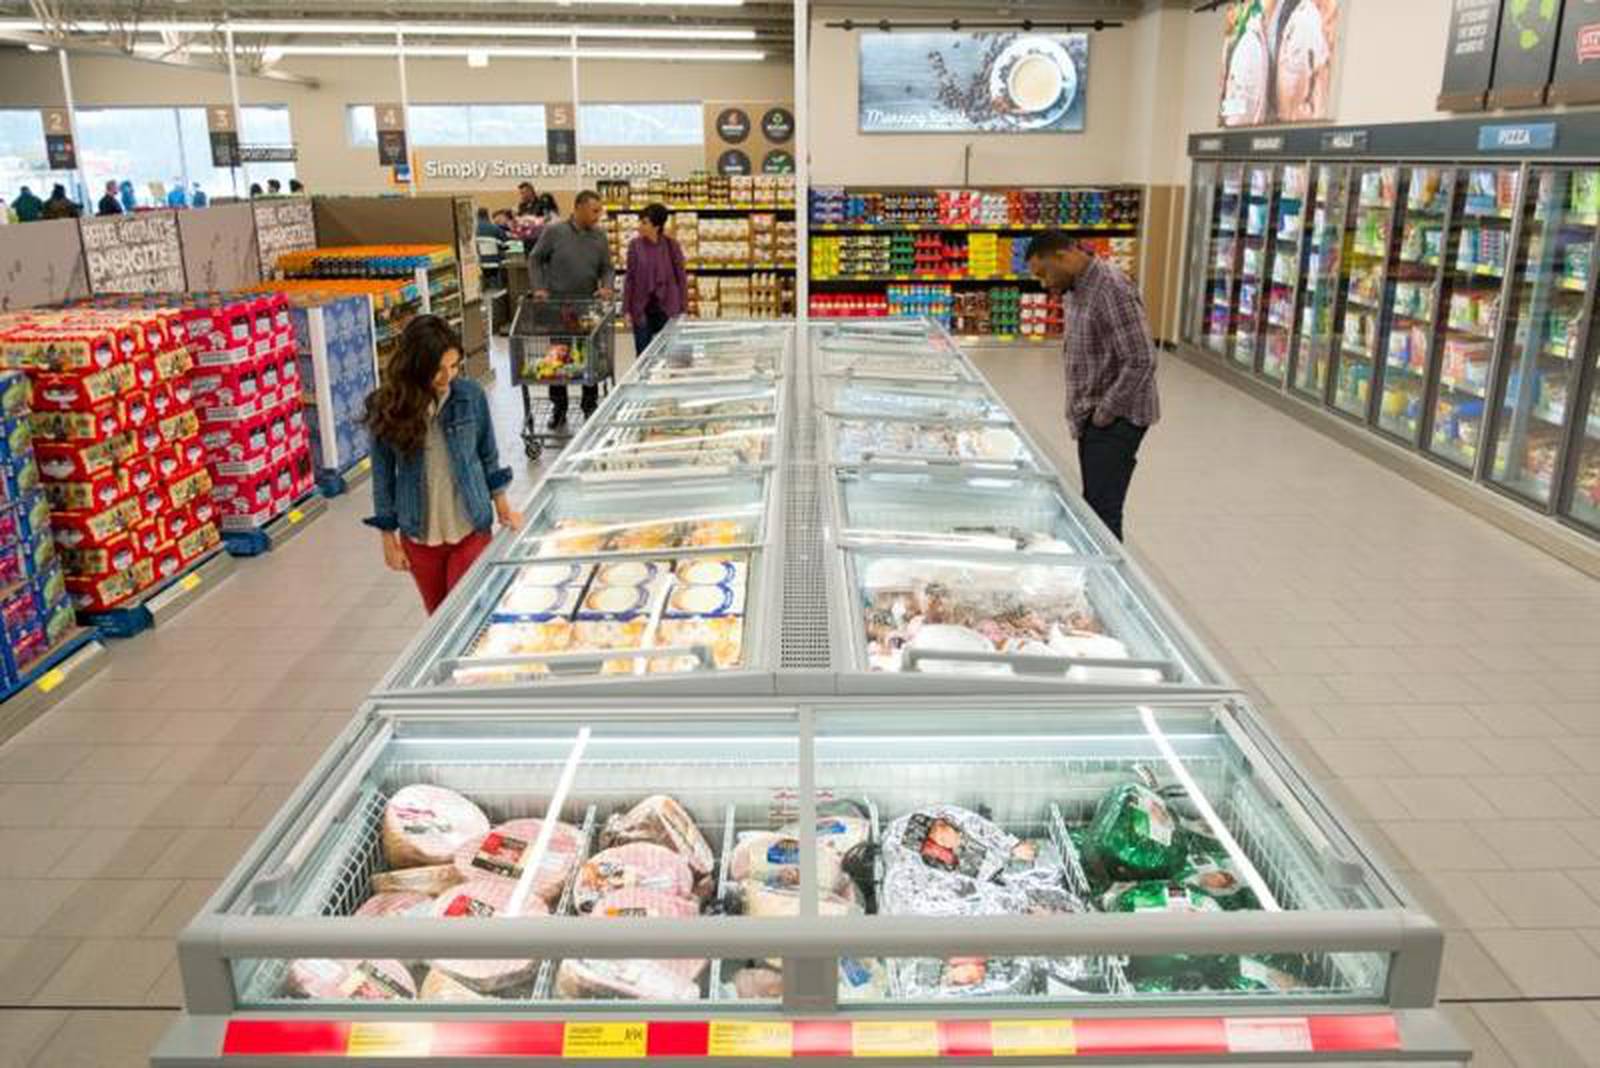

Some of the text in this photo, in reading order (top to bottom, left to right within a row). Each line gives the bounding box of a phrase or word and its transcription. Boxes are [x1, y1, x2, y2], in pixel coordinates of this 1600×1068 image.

[50, 112, 63, 129] 2
[215, 109, 229, 127] 3
[383, 108, 397, 126] 4
[554, 107, 567, 124] 5
[1497, 129, 1531, 145] PIZZA
[424, 160, 488, 180] Simply
[493, 160, 567, 176] Smarter
